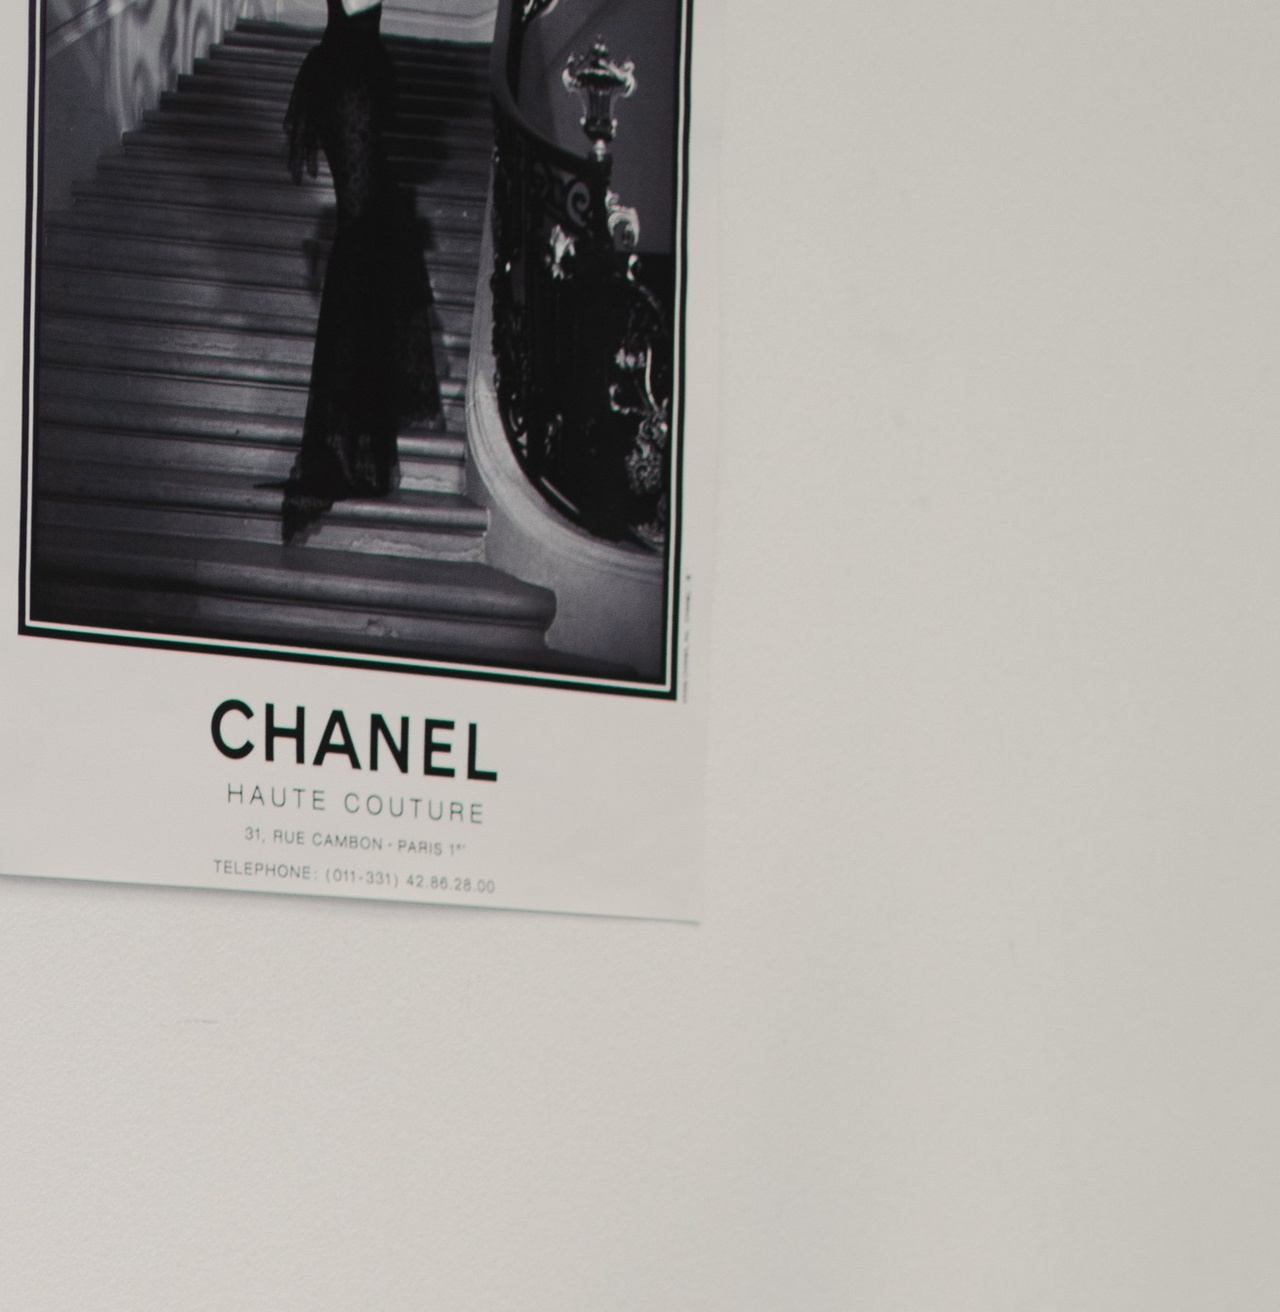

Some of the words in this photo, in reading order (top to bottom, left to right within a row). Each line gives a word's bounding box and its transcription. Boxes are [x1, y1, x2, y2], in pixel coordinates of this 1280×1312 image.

[209, 698, 499, 783] CHANEL
[227, 783, 326, 811] HAUTE
[344, 793, 484, 825] COUTURE
[244, 826, 265, 843] 31,
[273, 830, 305, 845] RUE
[311, 832, 383, 851] CAMBON
[397, 839, 443, 856] PARIS
[213, 859, 318, 881] TELEPHONE:
[325, 868, 400, 888] (011-331)
[406, 874, 495, 894] 42.86.28.00
